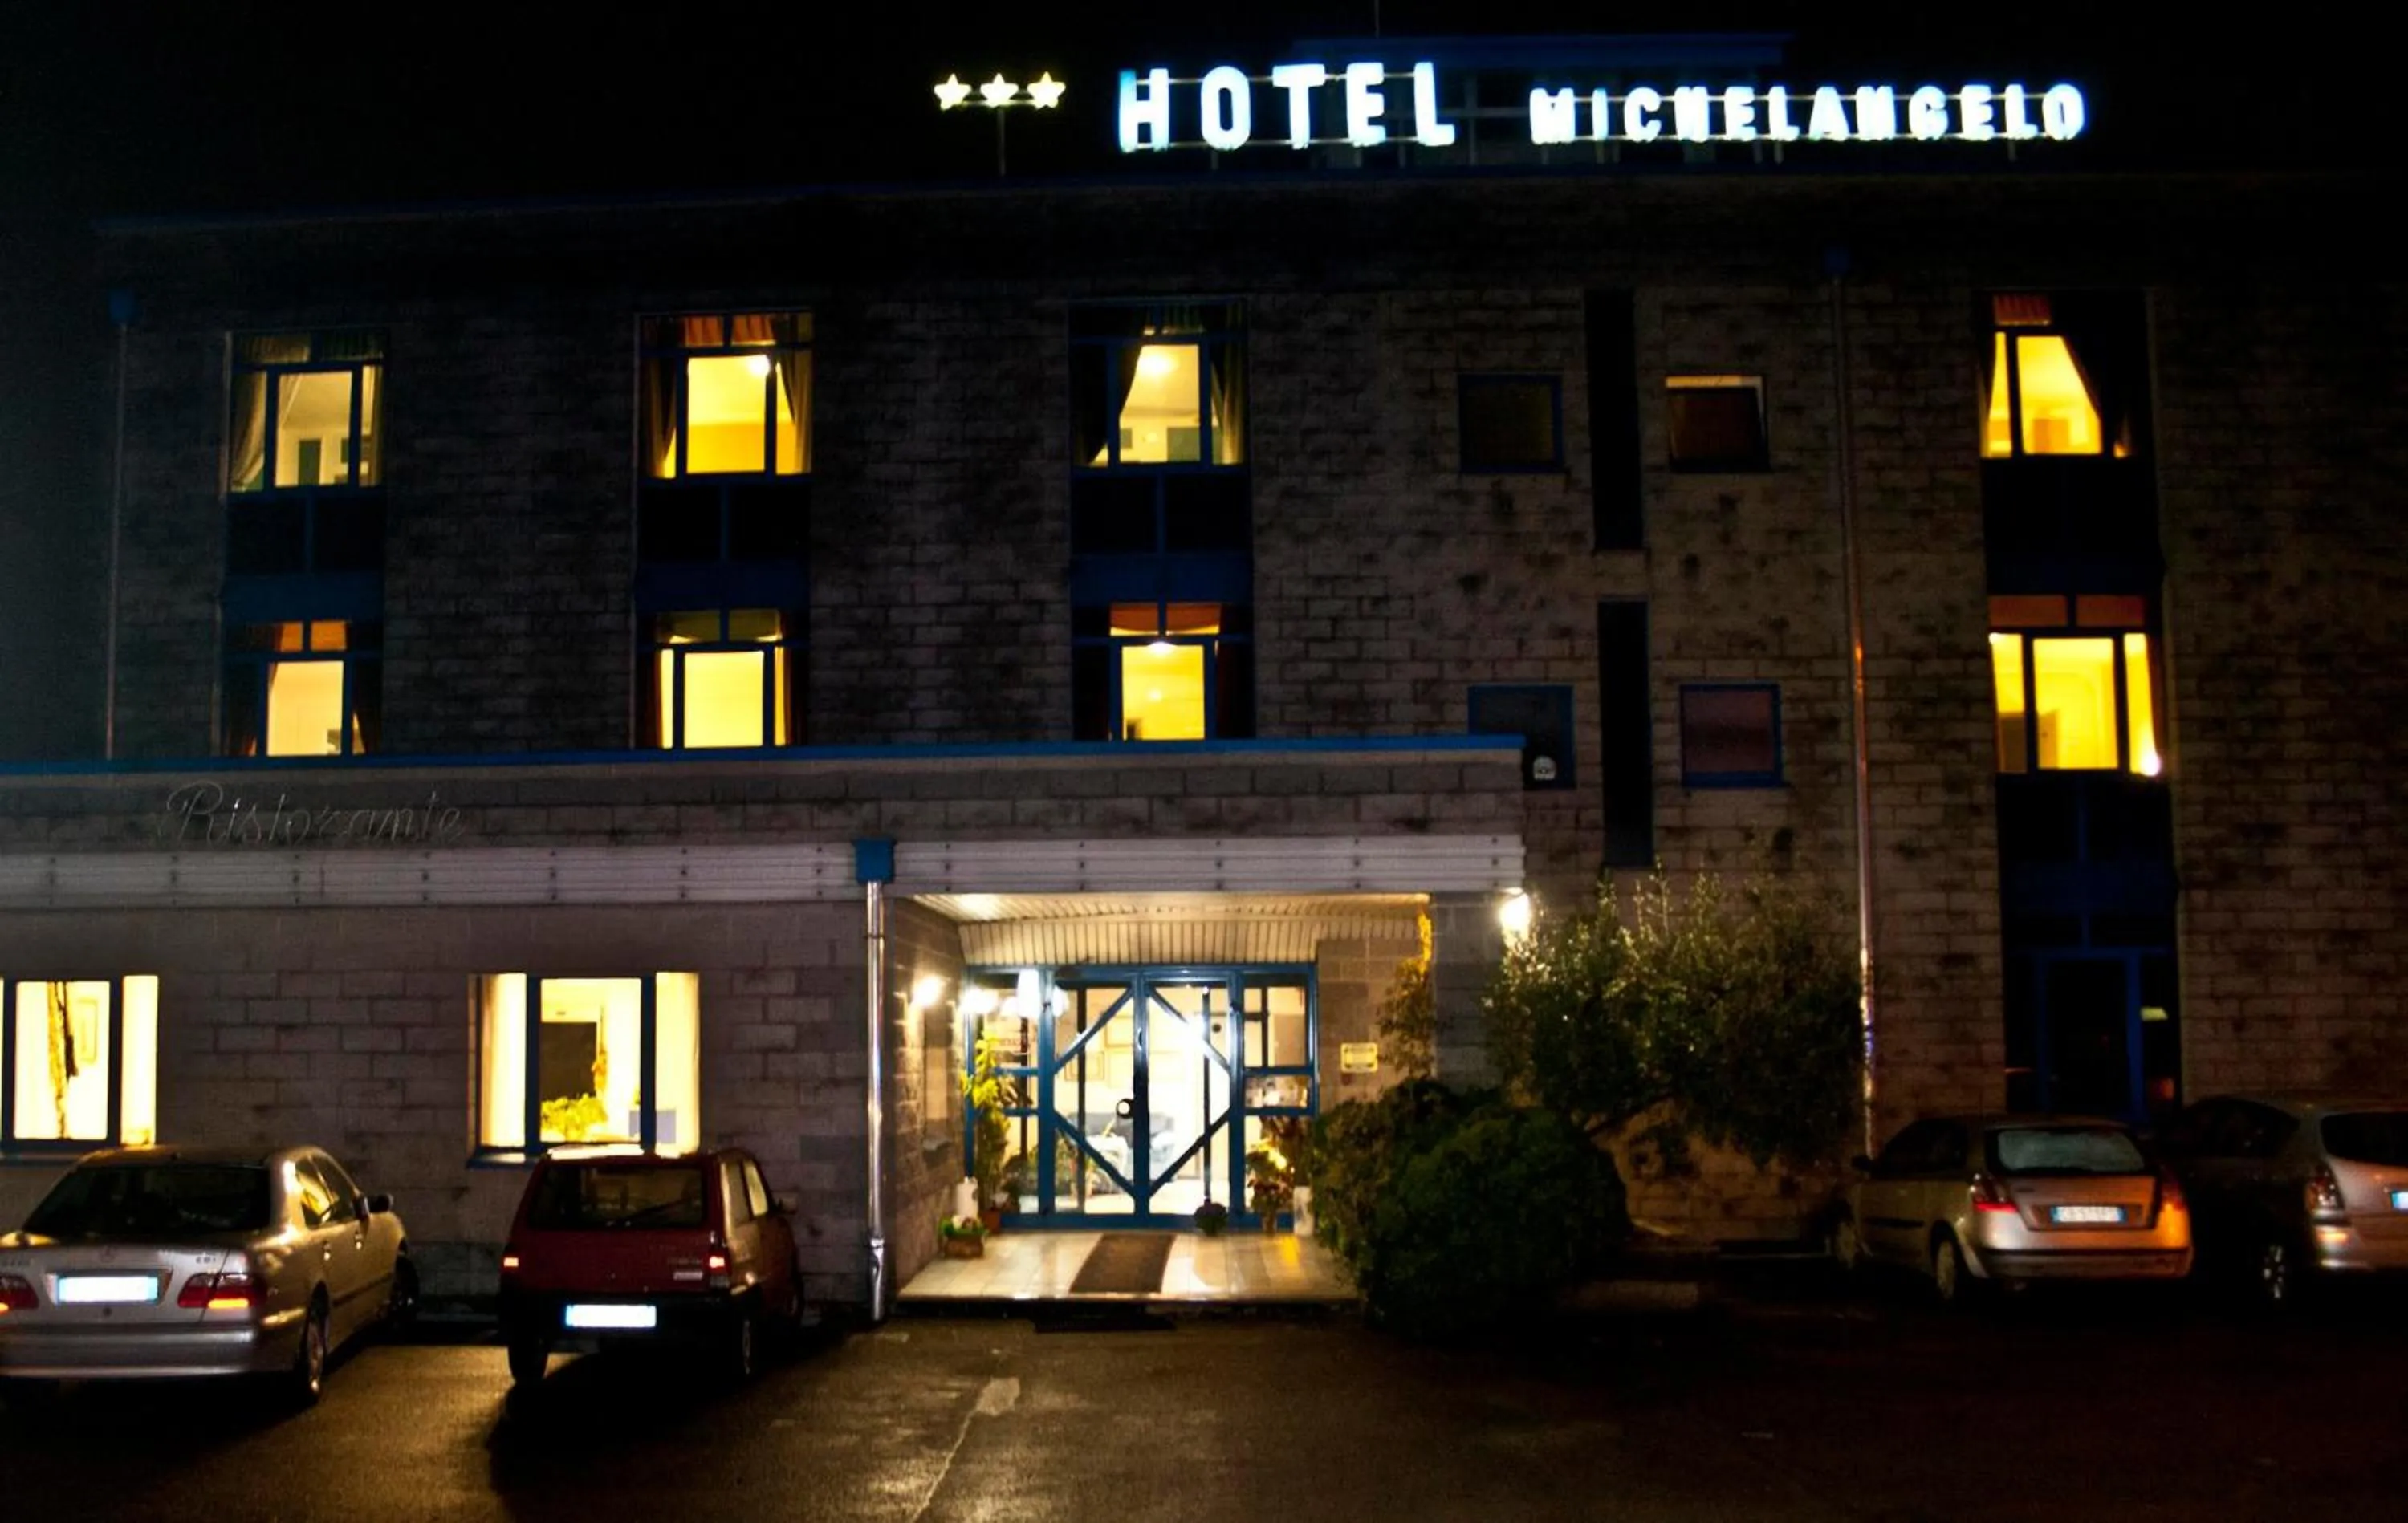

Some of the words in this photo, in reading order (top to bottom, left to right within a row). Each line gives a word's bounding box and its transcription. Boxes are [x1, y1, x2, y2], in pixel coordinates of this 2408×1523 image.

[1118, 62, 1455, 152] HOTEL
[1529, 83, 2086, 144] MICHELANGELO
[166, 779, 463, 847] Ristorante
